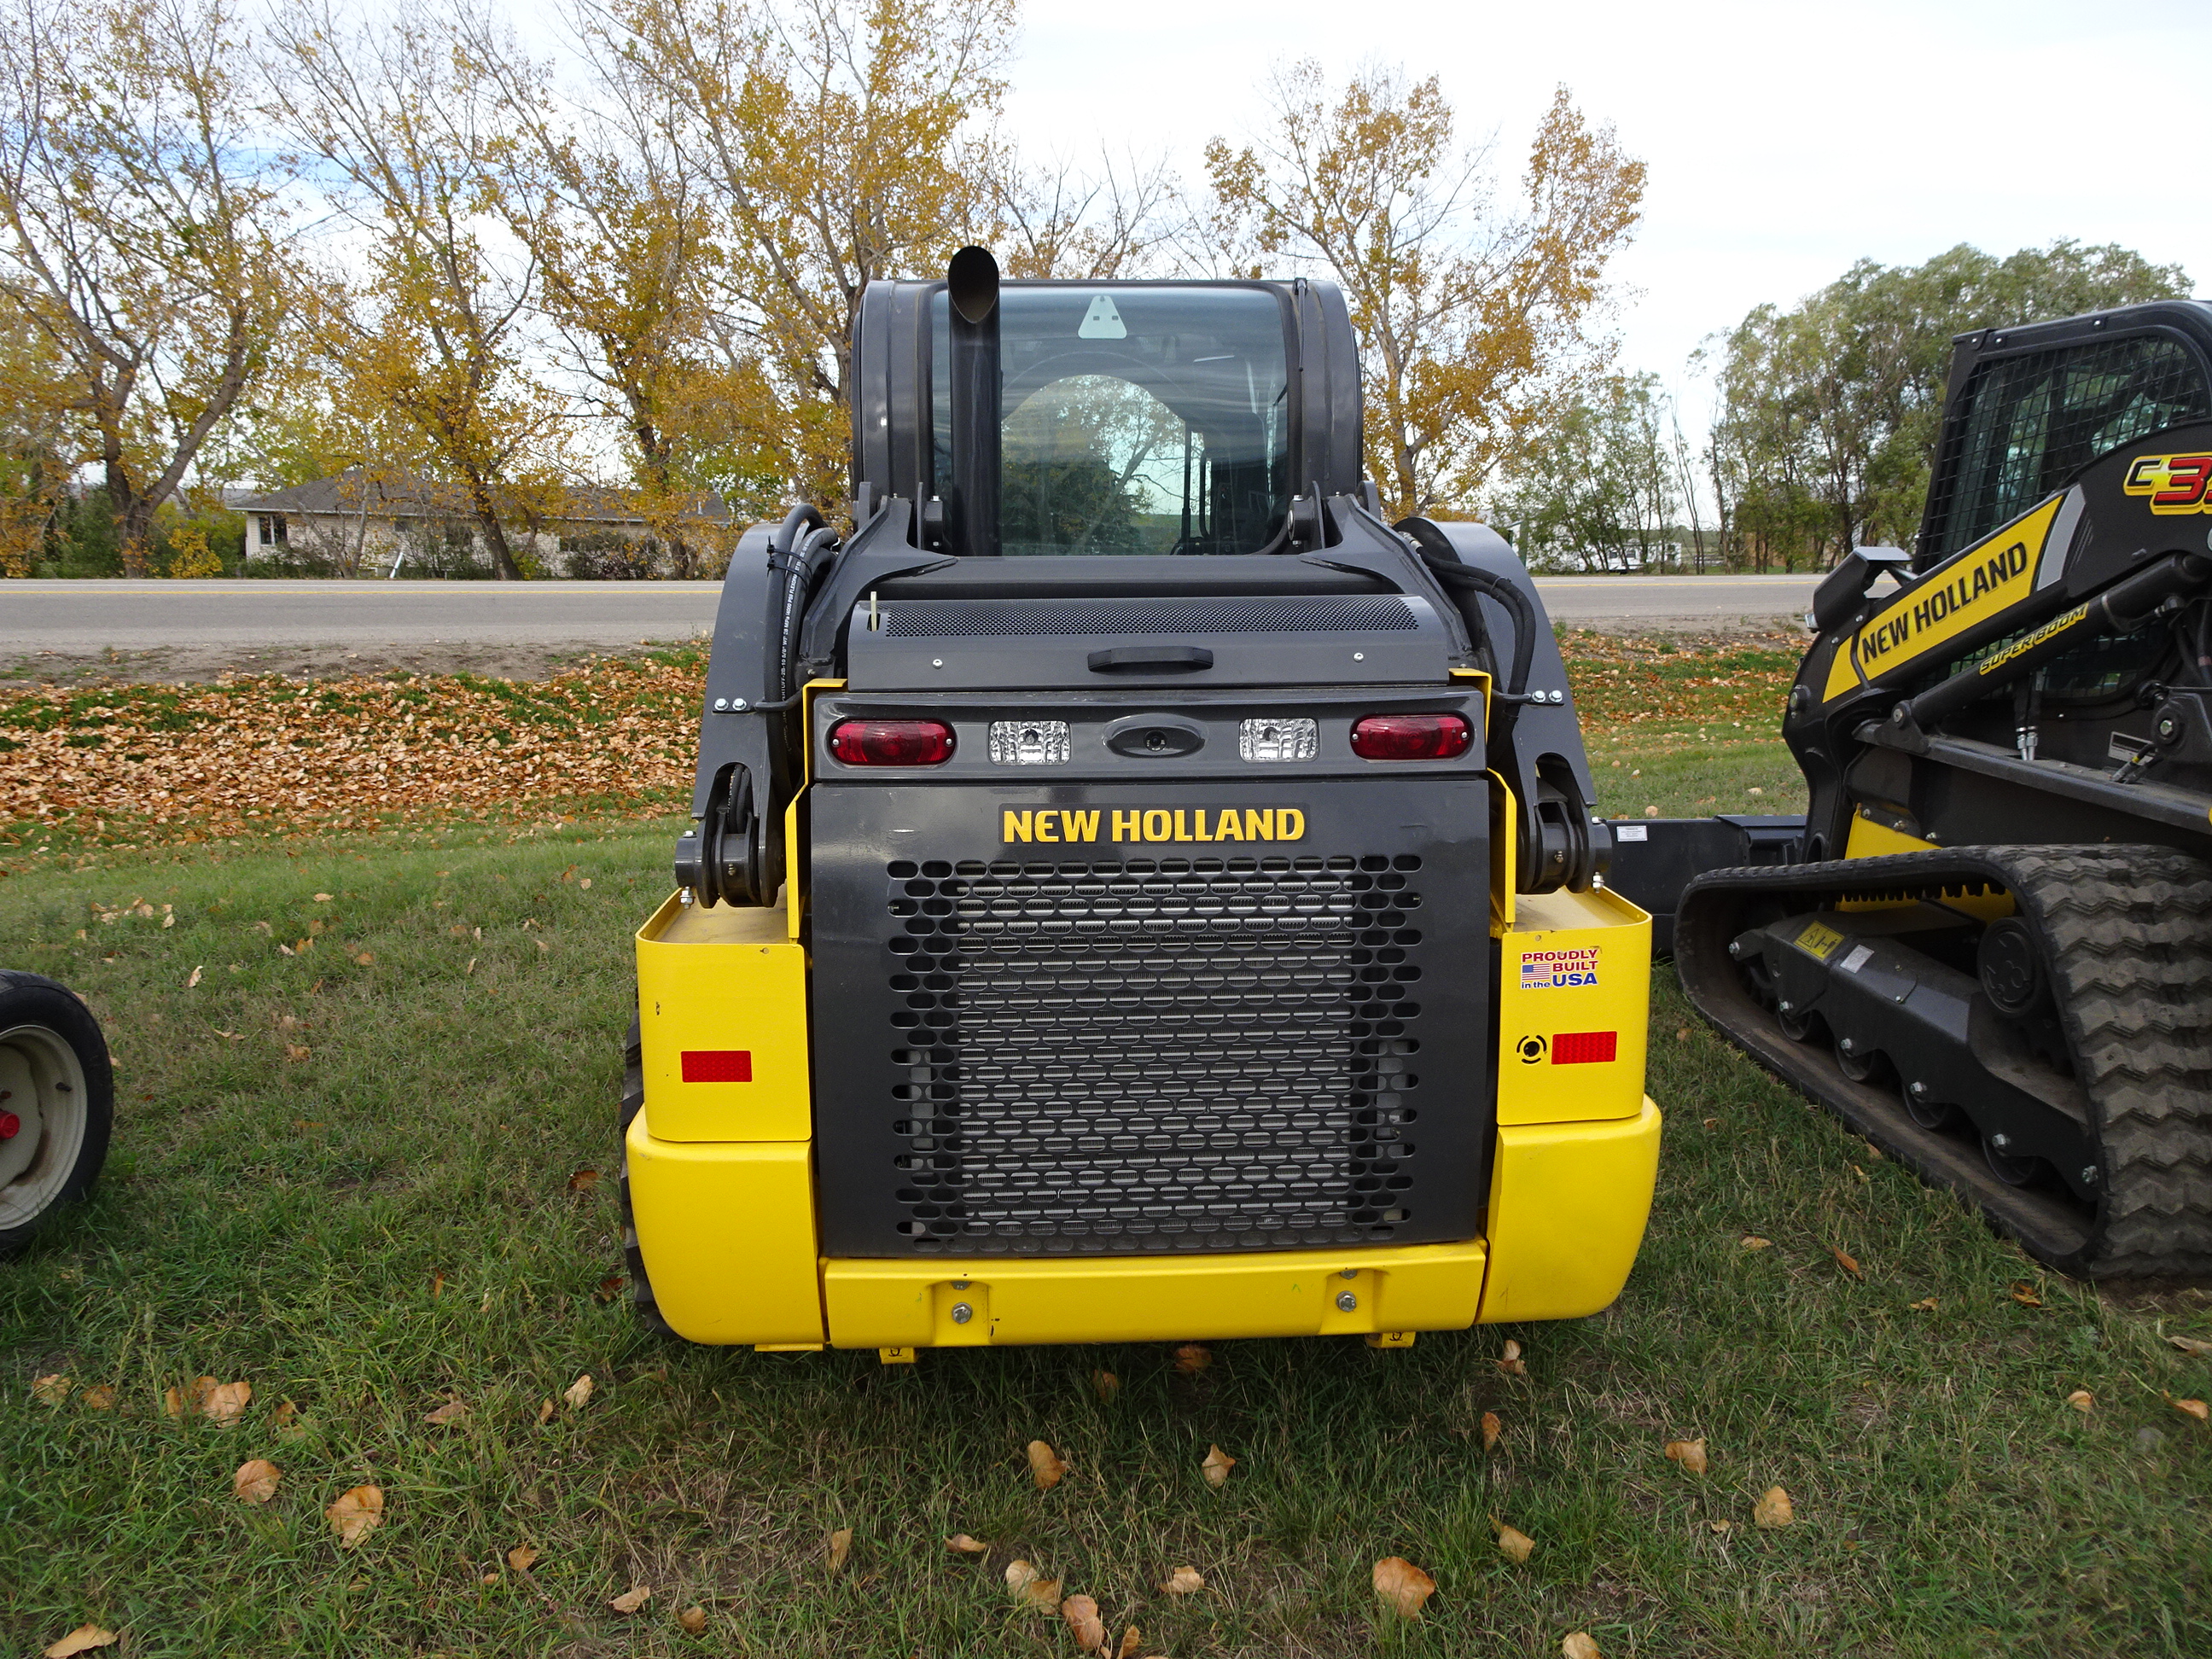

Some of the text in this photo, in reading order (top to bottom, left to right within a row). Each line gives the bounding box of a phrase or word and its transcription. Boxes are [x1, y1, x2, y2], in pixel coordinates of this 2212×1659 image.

[1861, 542, 2027, 664] NEW HOLLAND
[1980, 603, 2088, 673] SUPER BOOM
[1004, 808, 1305, 842] NEW HOLLAND
[1522, 949, 1598, 963] PROUDLY
[1552, 961, 1598, 972] BUILT
[1552, 972, 1598, 987] USA
